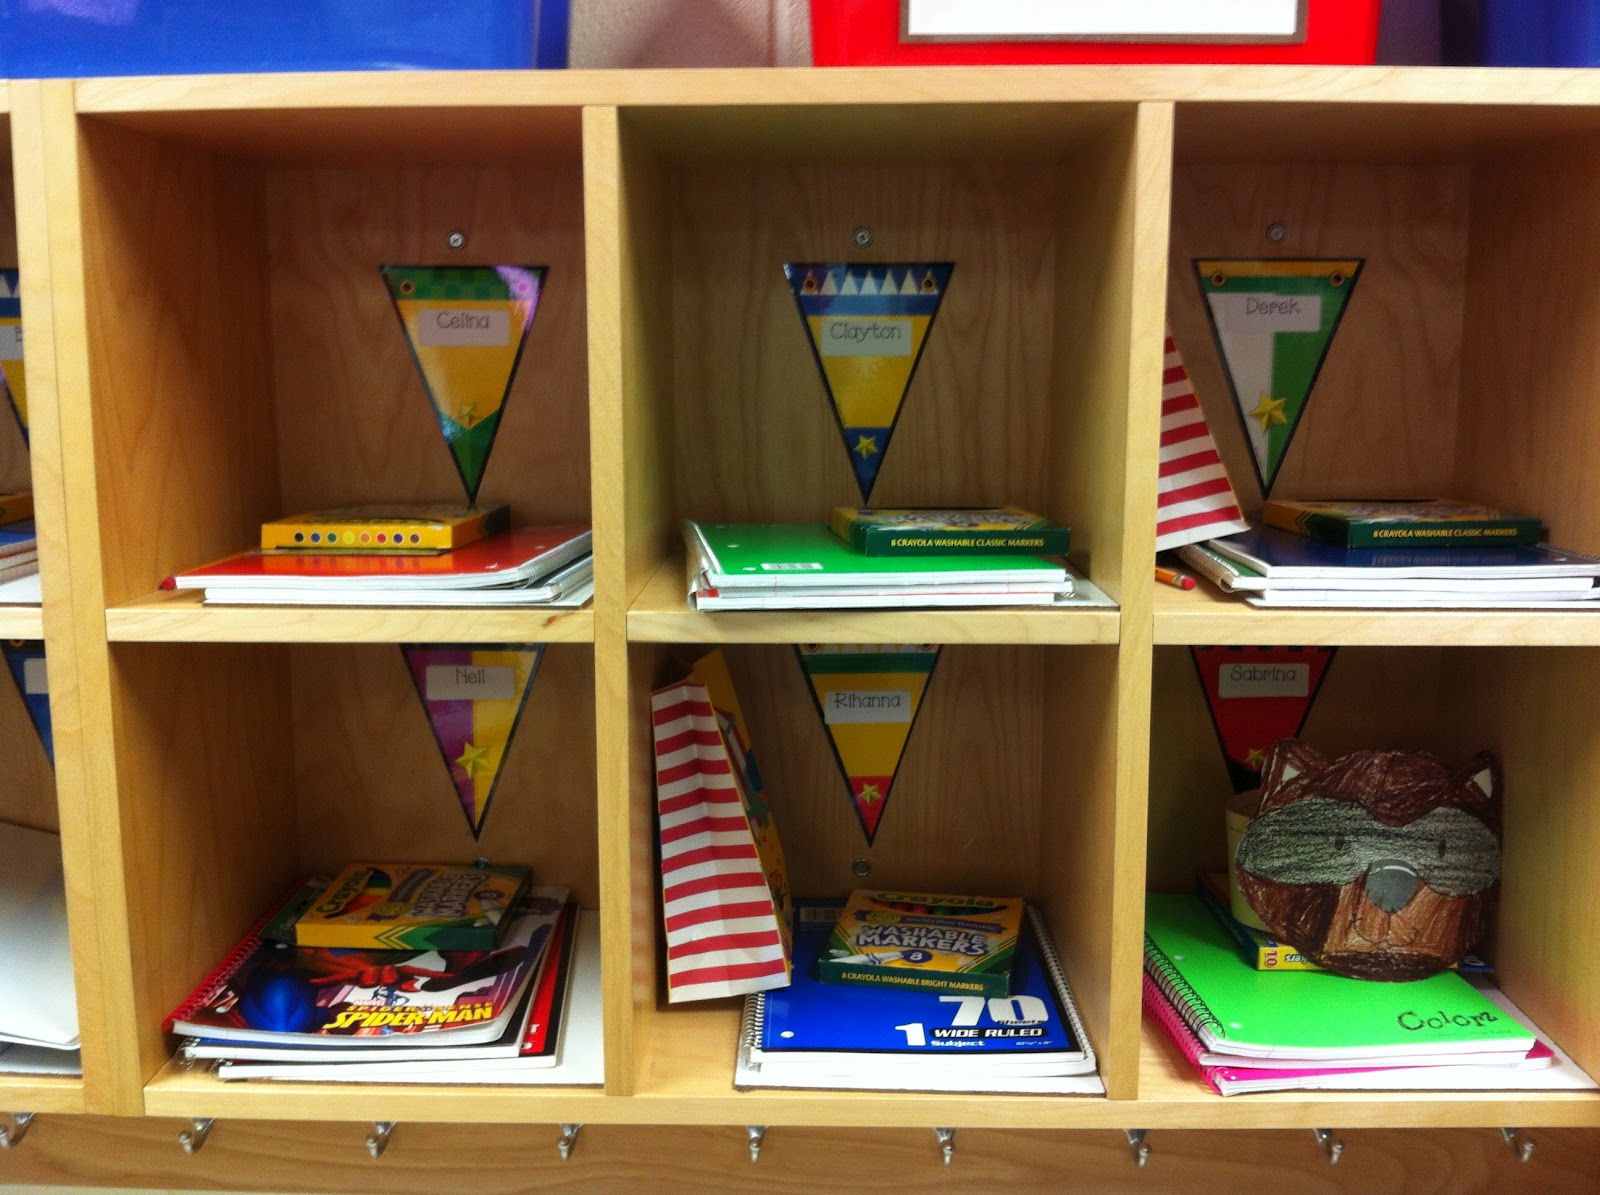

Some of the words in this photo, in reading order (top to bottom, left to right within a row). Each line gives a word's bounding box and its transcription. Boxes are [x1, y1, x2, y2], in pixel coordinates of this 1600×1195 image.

[1245, 297, 1301, 315] Derek
[436, 311, 490, 330] Celina
[829, 322, 901, 343] Clayton
[1378, 529, 1413, 538] CRAYOLA
[1414, 528, 1453, 538] WASHABLE
[1453, 528, 1483, 537] CLASSIC
[1483, 528, 1518, 537] MARKERS
[891, 539, 896, 547] 8
[897, 538, 933, 547] CRAYOLA
[934, 538, 975, 547] WASHABLE
[975, 538, 1007, 547] CLASSIC
[1007, 538, 1044, 547] MARKERS
[1230, 665, 1297, 681] Sabrina
[834, 693, 901, 709] Rihanna
[862, 925, 988, 946] WASHABLE
[857, 933, 988, 957] MARKERS
[909, 952, 924, 961] 8
[847, 973, 882, 982] CRAYOLA
[882, 975, 921, 986] WASHABLE
[921, 978, 948, 988] BRIGHT
[948, 980, 985, 991] MARKERS
[346, 1005, 417, 1013] SPIDER
[938, 995, 1050, 1026] 70
[894, 1022, 926, 1046] 1
[933, 1028, 979, 1038] WIDE
[984, 1028, 1043, 1037] RULED
[930, 1040, 985, 1048] Subject
